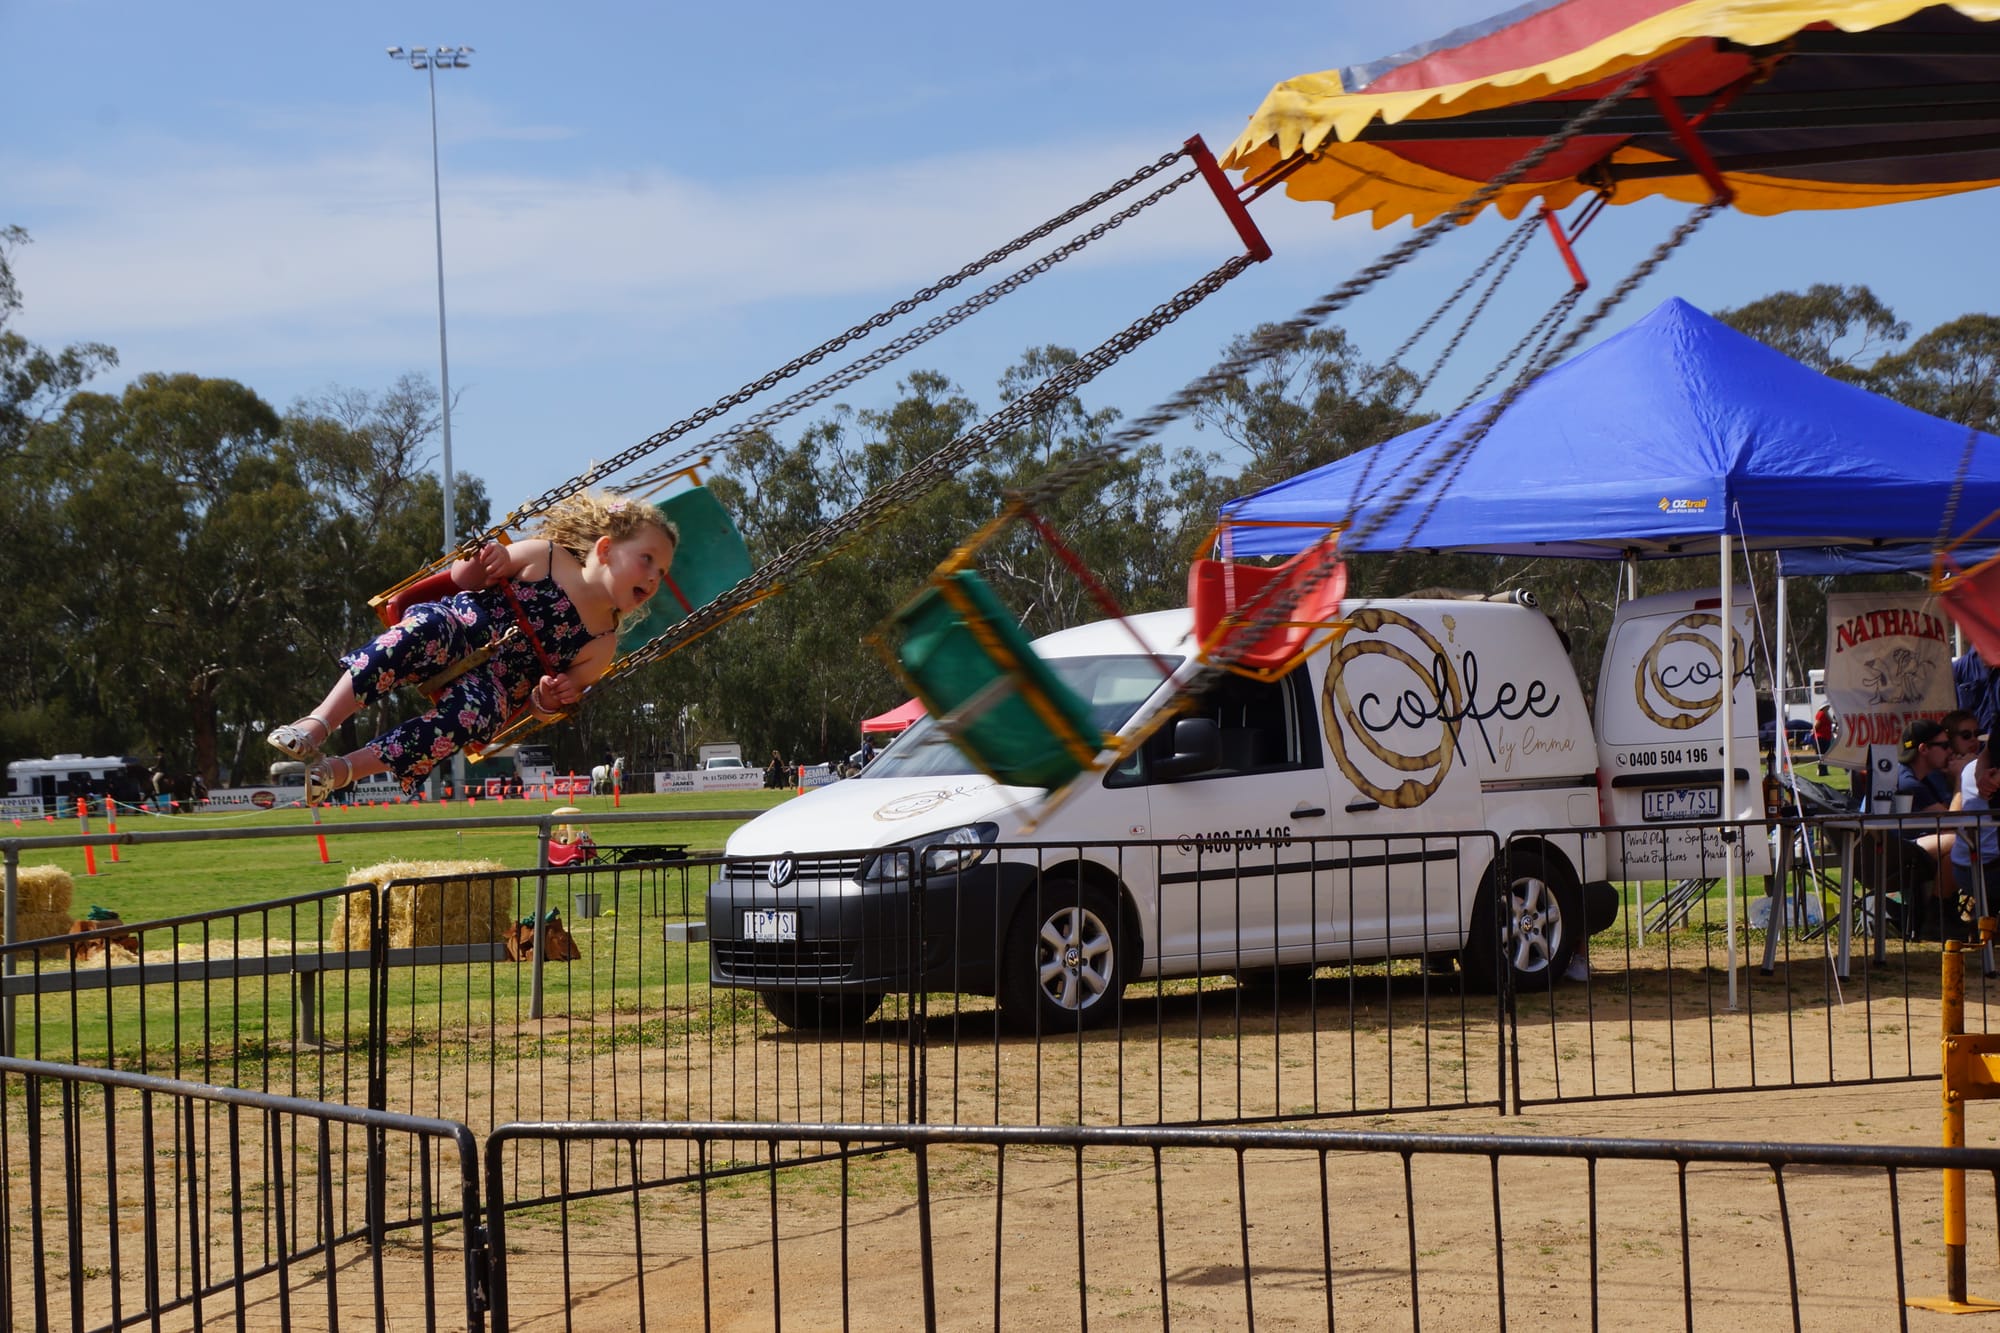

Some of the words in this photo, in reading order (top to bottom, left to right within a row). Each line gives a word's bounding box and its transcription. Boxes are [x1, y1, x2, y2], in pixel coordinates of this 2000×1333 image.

[1672, 498, 1708, 509] OZtrail
[1836, 609, 1948, 653] NATHALIA
[1359, 650, 1560, 767] coffee
[1843, 711, 1902, 748] YOUNG
[1629, 751, 1657, 767] 0400
[1660, 749, 1682, 765] 504
[1686, 748, 1708, 763] 196
[1648, 793, 1675, 812] 1EP
[1687, 791, 1716, 810] 7SL
